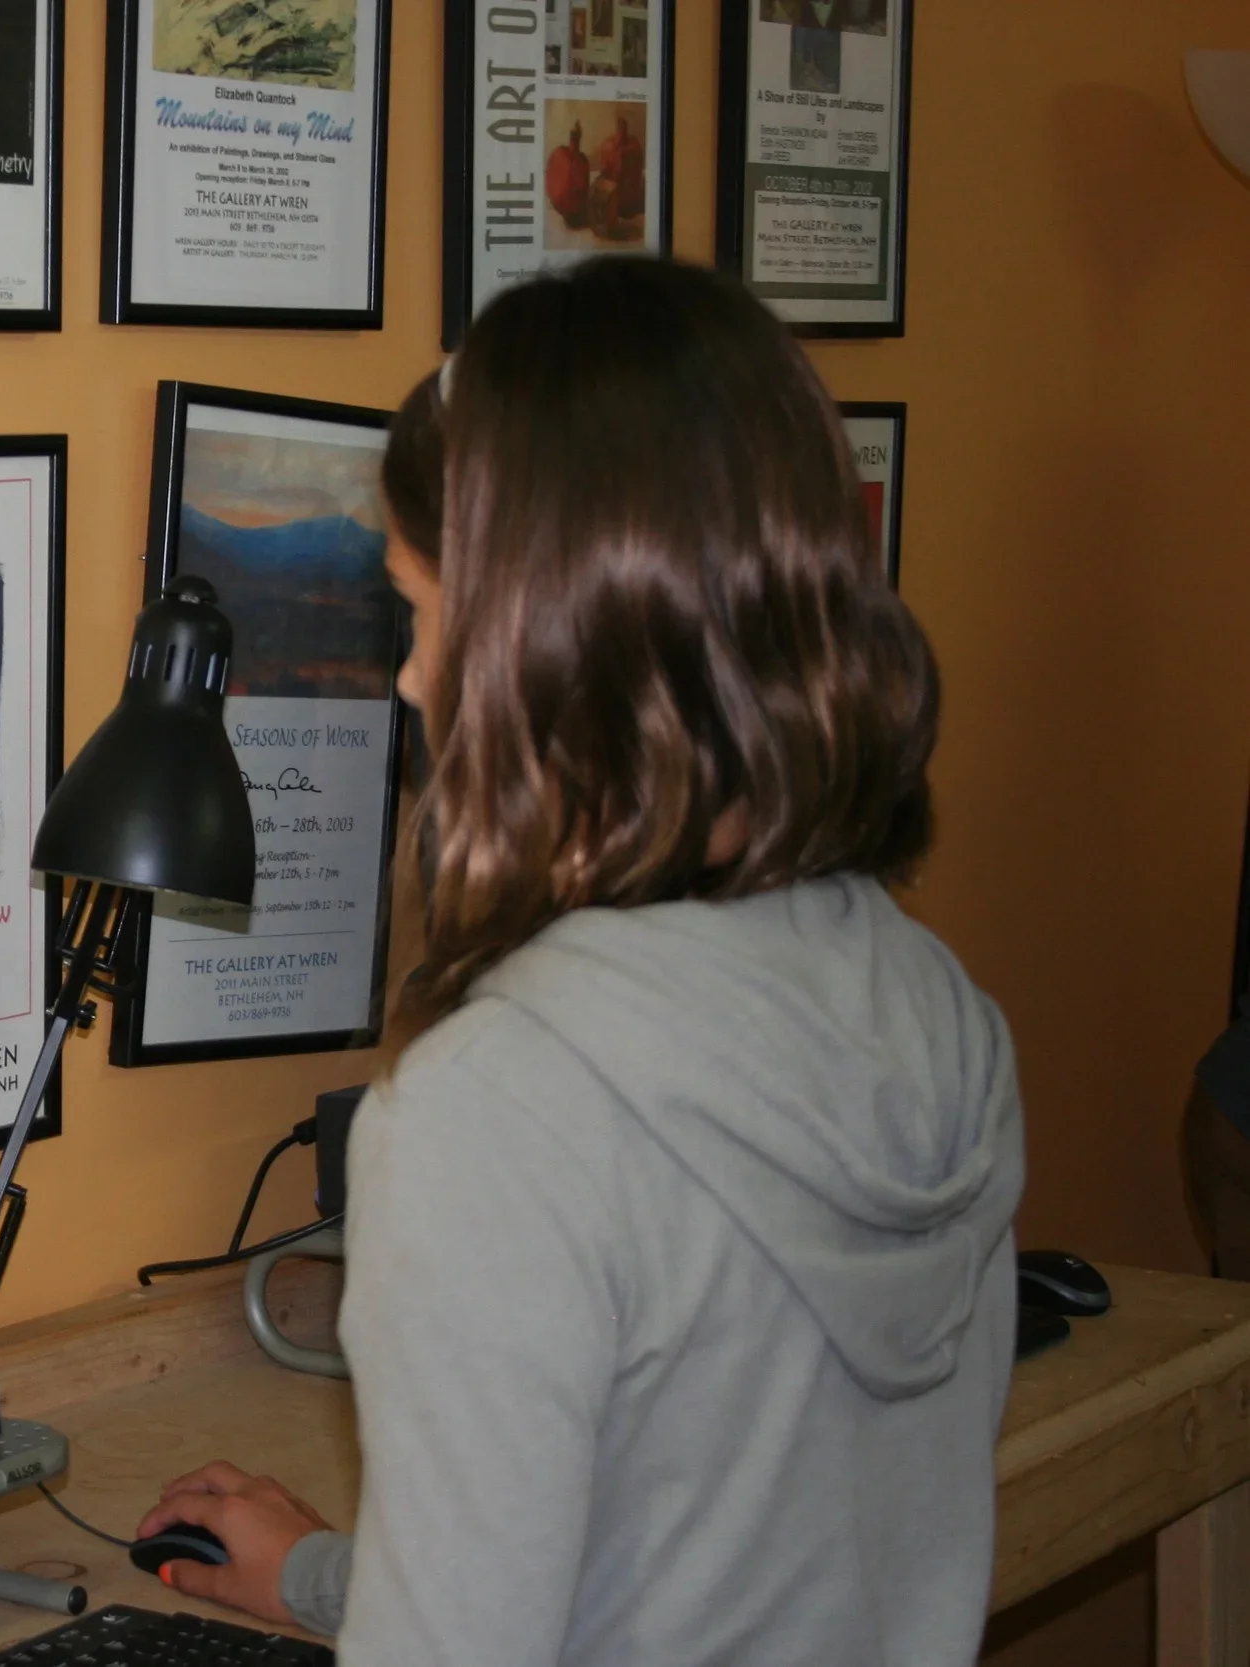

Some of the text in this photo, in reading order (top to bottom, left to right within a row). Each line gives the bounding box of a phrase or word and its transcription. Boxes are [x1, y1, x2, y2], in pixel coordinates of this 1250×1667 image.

[487, 6, 537, 35] O
[214, 86, 297, 106] Elizabeth Quantock
[485, 58, 537, 144] ART
[757, 89, 764, 102] A
[764, 90, 785, 104] Show
[786, 92, 794, 104] of
[829, 97, 842, 109] and
[843, 98, 885, 114] Landscapes
[156, 96, 355, 148] Mountains on my Mind
[816, 109, 827, 125] by
[169, 142, 178, 152] An
[179, 144, 210, 154] exhibition
[212, 145, 219, 155] of
[283, 151, 294, 161] and
[295, 152, 318, 163] Stained
[318, 154, 336, 165] Glass
[765, 175, 808, 192] OCTOBER
[195, 189, 309, 210] THE GALLERY AT WREN
[200, 207, 221, 219] MAIN
[221, 208, 246, 220] STREET
[485, 171, 535, 252] THE
[771, 220, 788, 230] THE
[789, 219, 827, 231] GALLERY
[841, 222, 863, 233] WREN
[757, 232, 782, 243] MAIN
[861, 236, 878, 247] NH
[233, 724, 369, 749] SEASONS OF WORK
[326, 816, 354, 832] 2003
[267, 850, 310, 865] Reception
[325, 868, 340, 882] pm
[265, 900, 302, 915] September
[185, 951, 338, 974] THE GALLERY AT WREN
[215, 973, 309, 990] 2011 MAIN STREET
[286, 989, 304, 1001] NH
